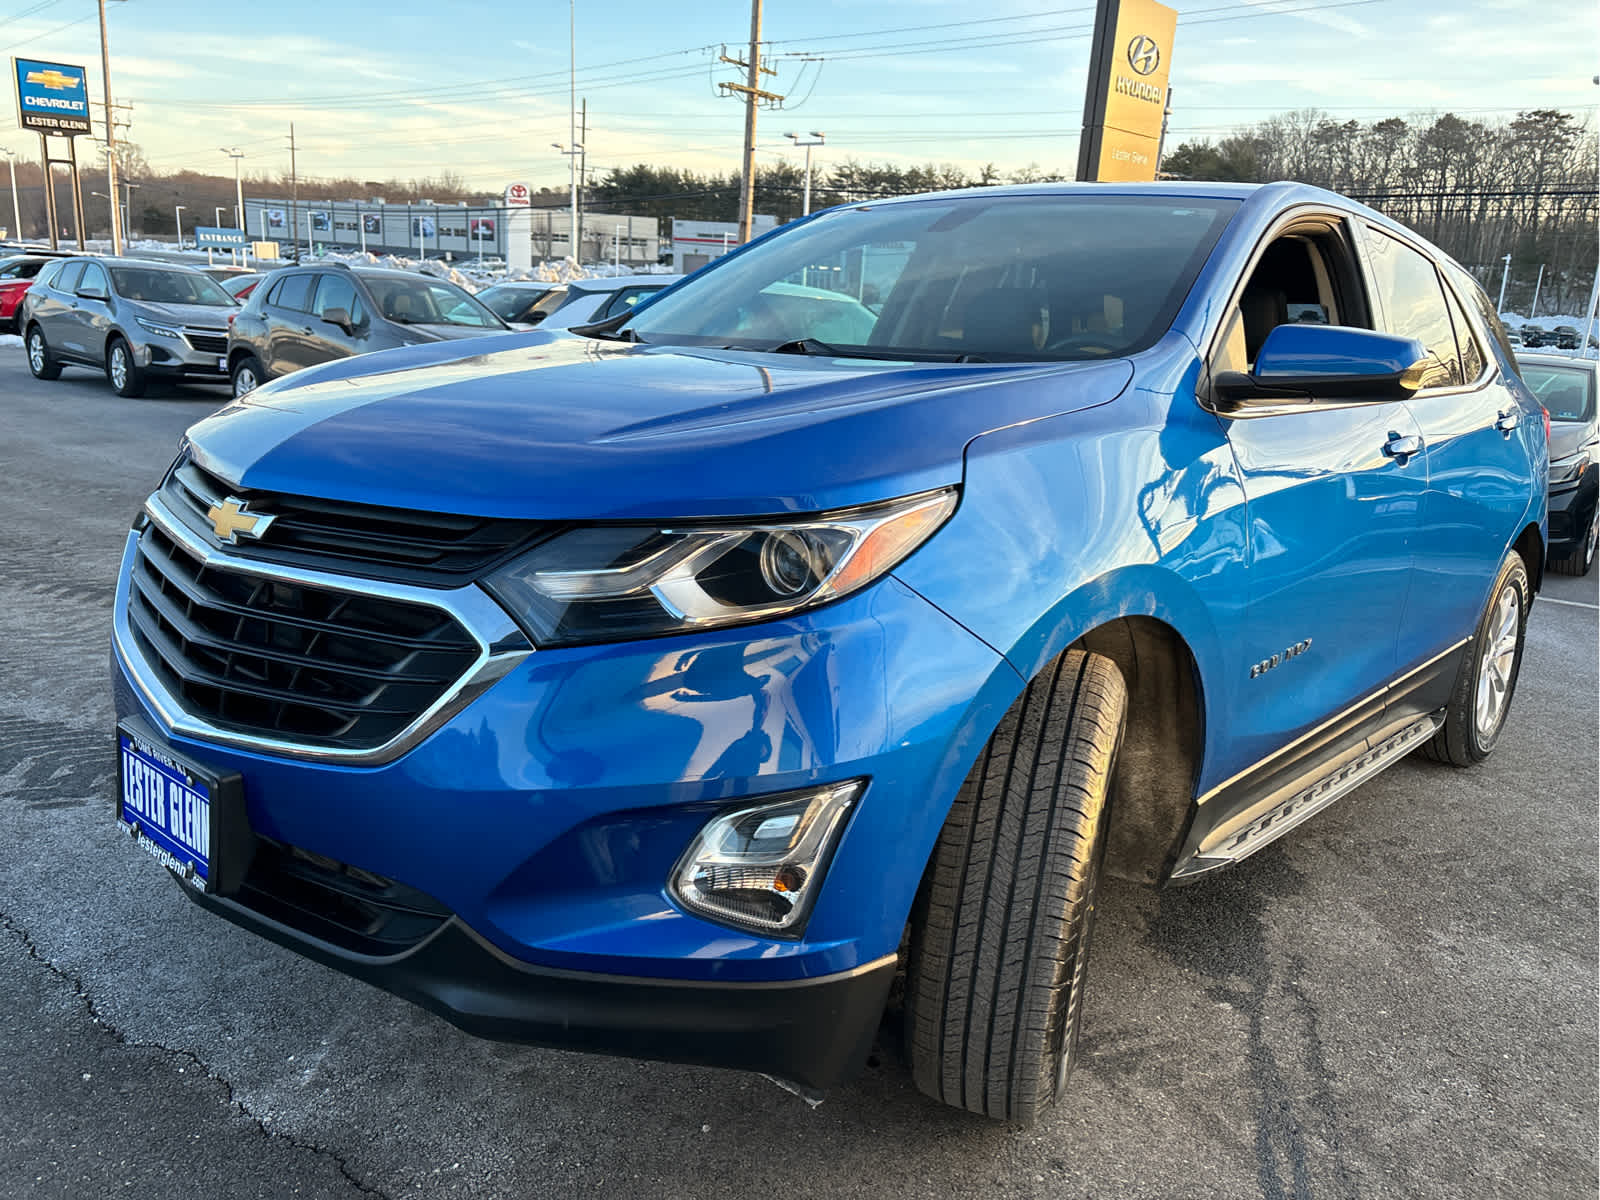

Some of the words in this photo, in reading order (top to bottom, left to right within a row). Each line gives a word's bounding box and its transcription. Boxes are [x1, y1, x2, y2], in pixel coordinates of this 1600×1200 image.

[24, 95, 84, 110] CHEVROLET
[1115, 75, 1162, 104] HYUNDAI
[26, 116, 58, 127] LESTER
[59, 119, 88, 130] GLENN
[200, 232, 243, 243] ENTRANCE
[134, 736, 152, 756] TOMS
[176, 762, 187, 777] NJ
[122, 751, 166, 829] LESTER
[169, 782, 210, 859] GLENN
[137, 831, 187, 878] lesterglenn
